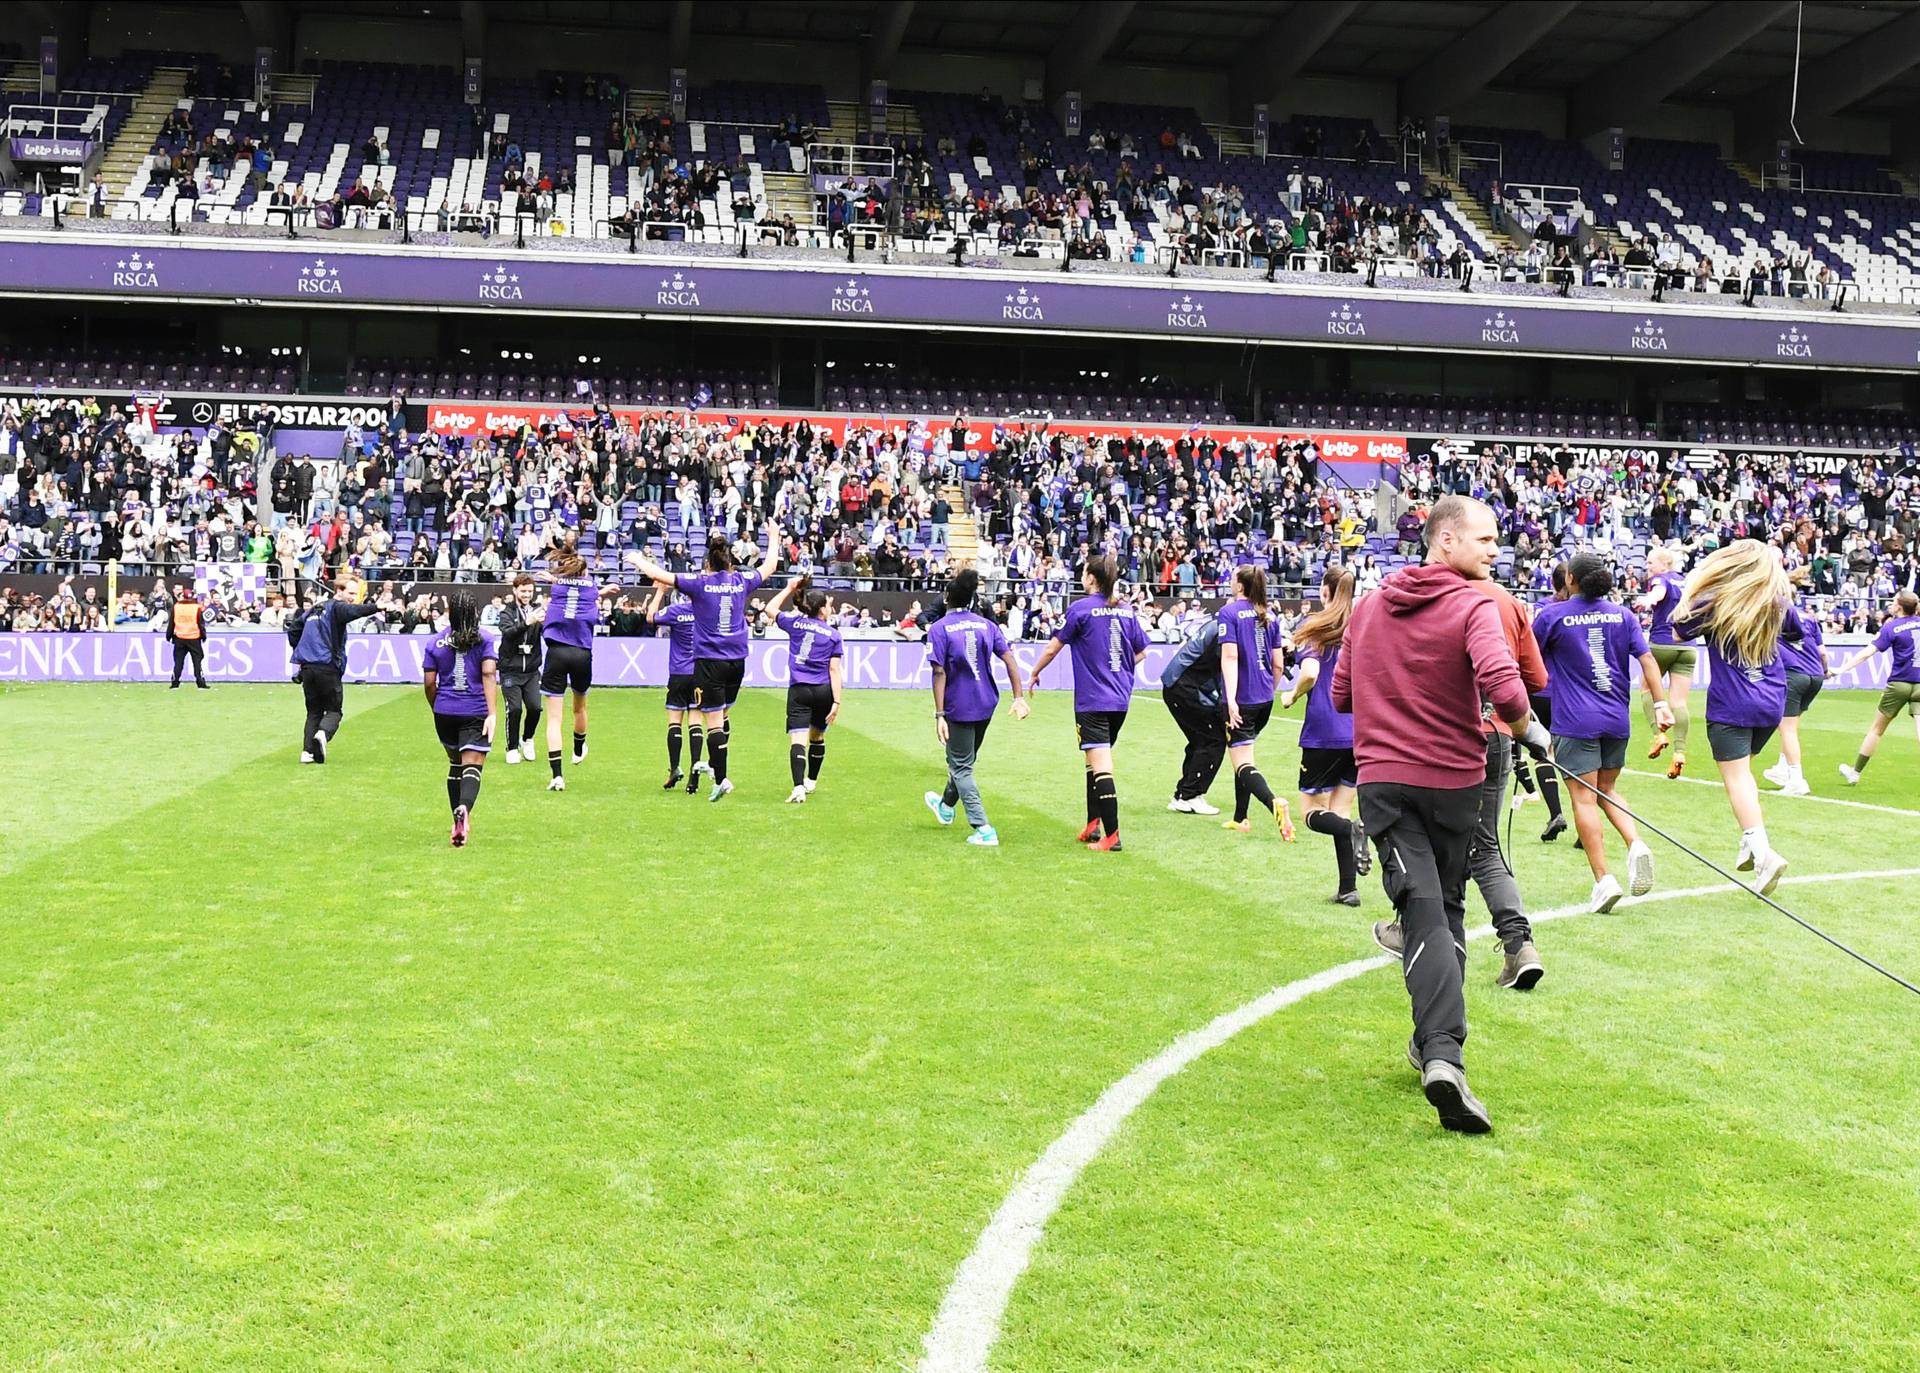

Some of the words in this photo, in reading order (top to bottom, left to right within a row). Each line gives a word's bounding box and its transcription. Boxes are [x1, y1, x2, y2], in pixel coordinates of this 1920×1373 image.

[62, 147, 82, 157] Park
[113, 272, 159, 288] RSCA
[298, 279, 342, 294] RSCA
[479, 285, 523, 300] RSCA
[657, 291, 700, 306] RSCA
[831, 298, 873, 312] RSCA
[1003, 306, 1043, 320] RSCA
[1167, 314, 1207, 328] RSCA
[1327, 322, 1366, 336] RSCA
[1482, 329, 1519, 343] RSCA
[1631, 336, 1668, 350] RSCA
[1777, 343, 1812, 357] RSCA
[1563, 612, 1623, 626] CHAMPIONS
[94, 637, 254, 676] LADES
[618, 643, 646, 680] X
